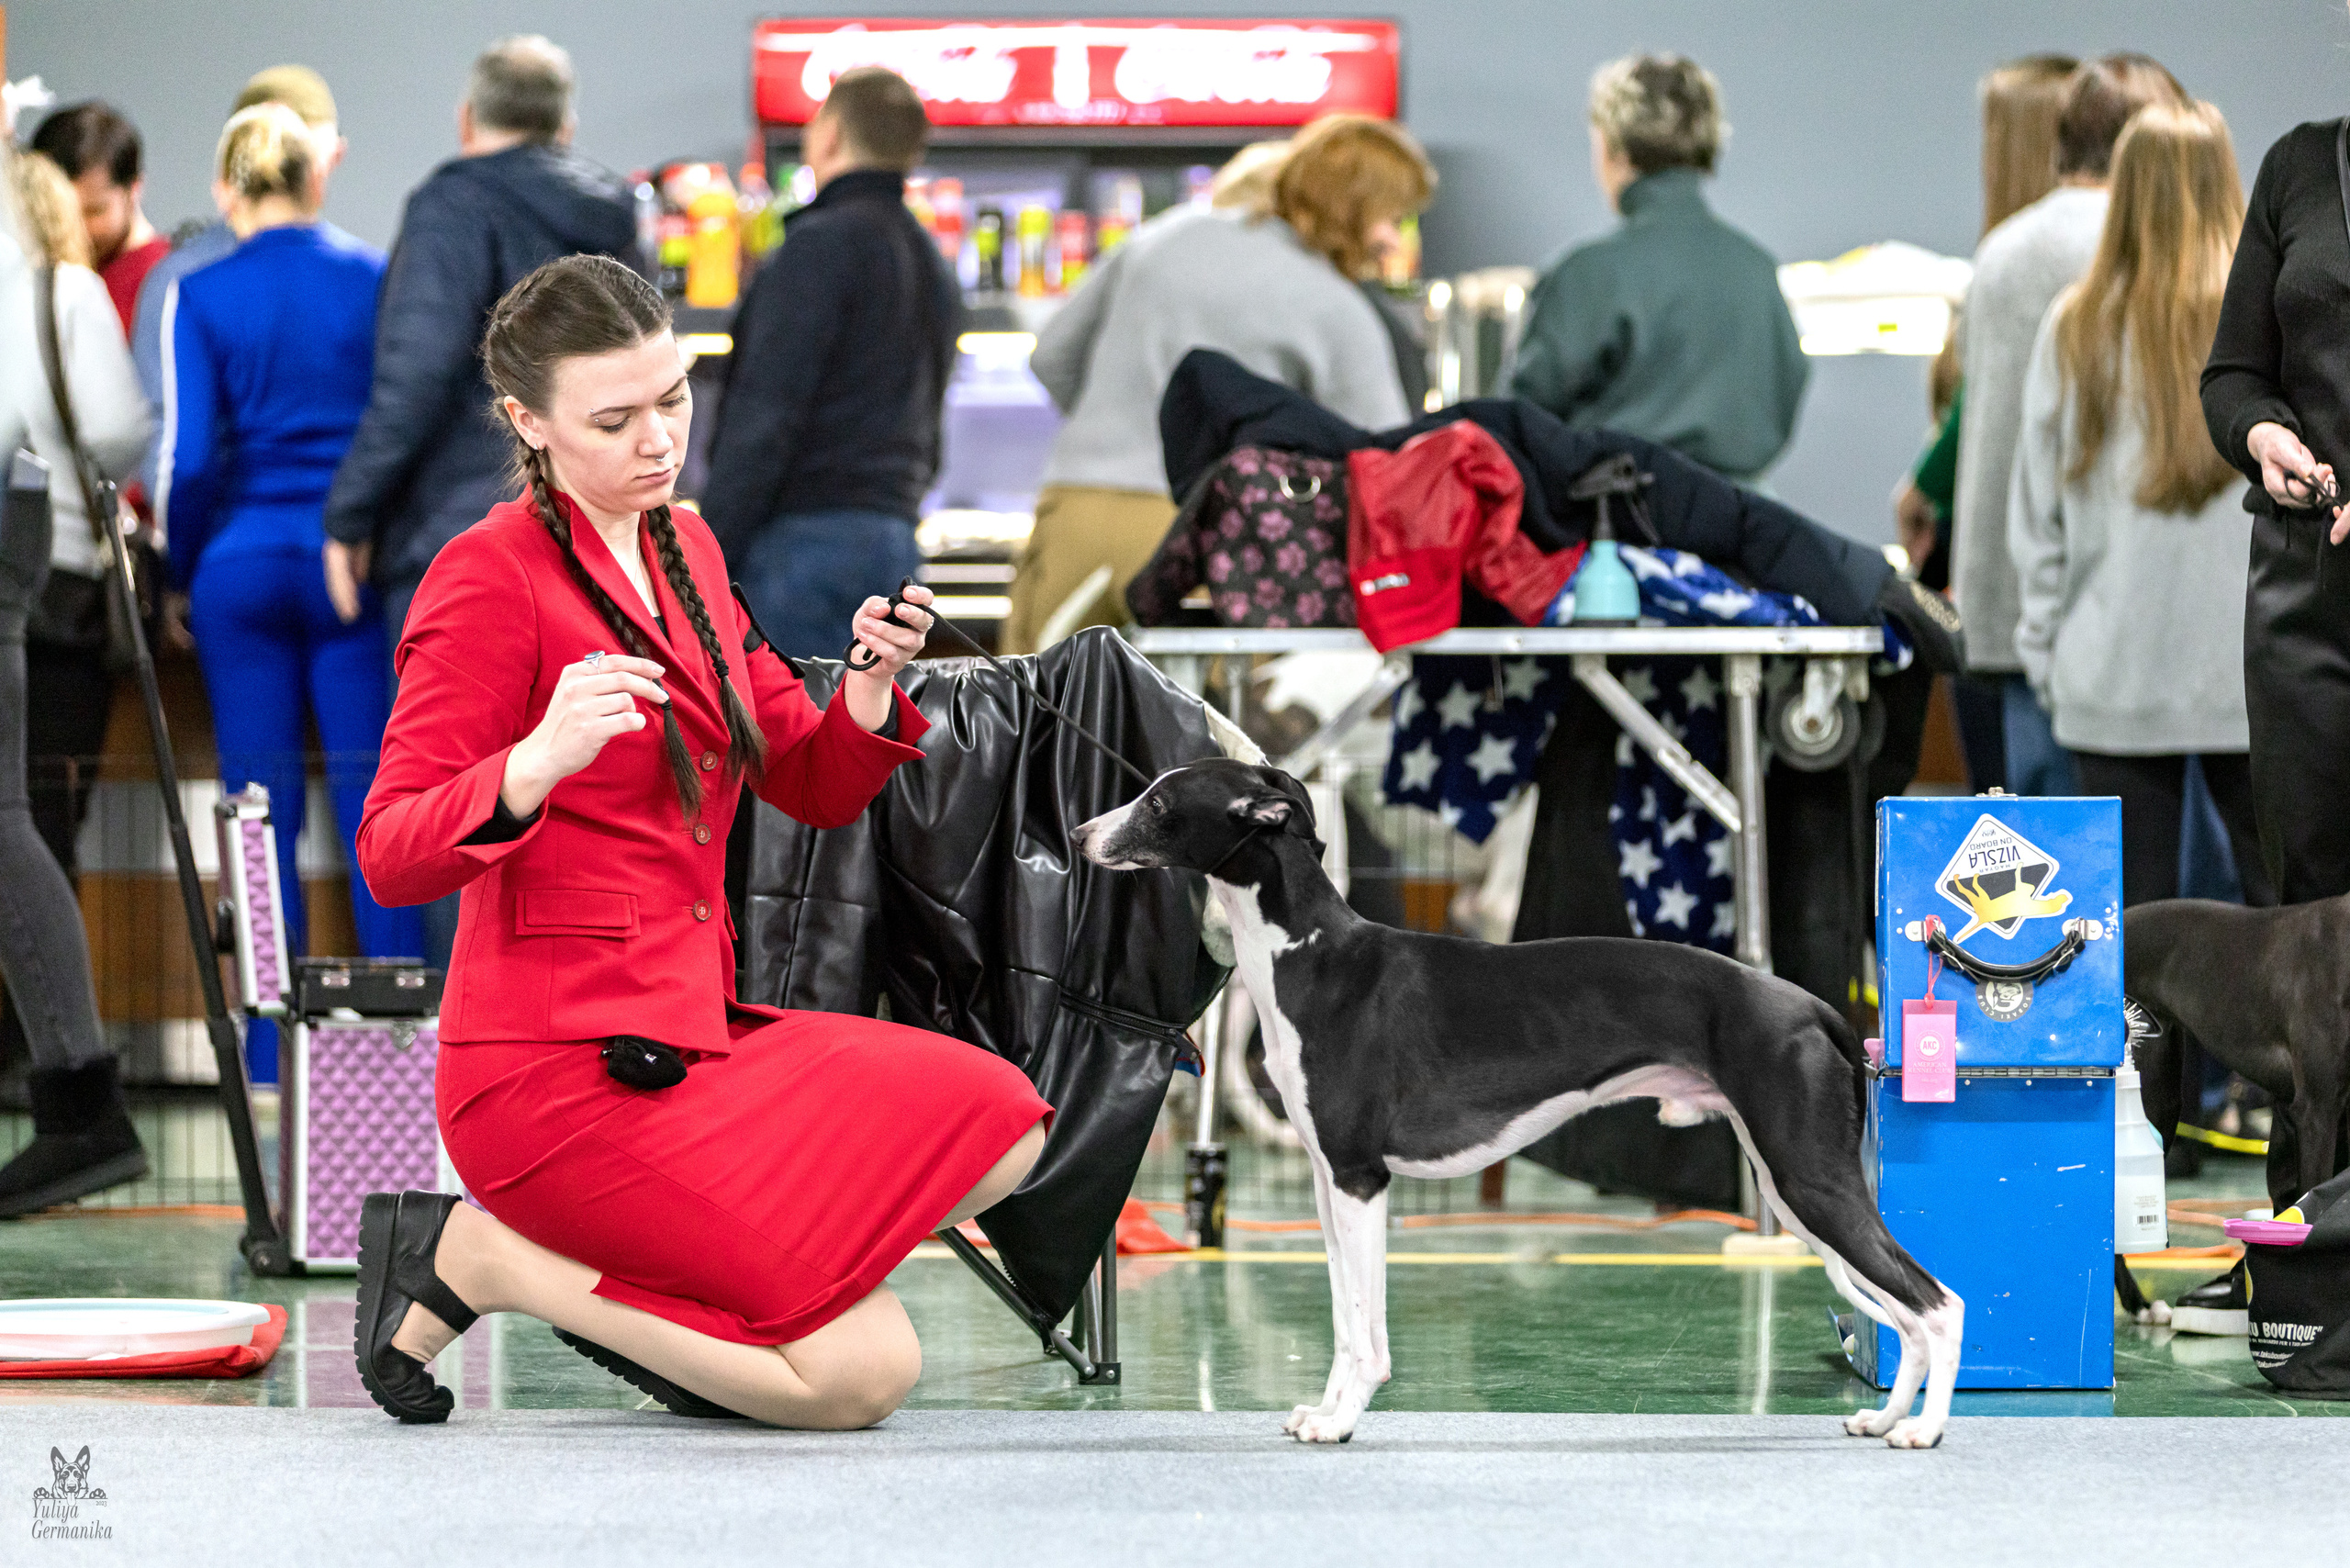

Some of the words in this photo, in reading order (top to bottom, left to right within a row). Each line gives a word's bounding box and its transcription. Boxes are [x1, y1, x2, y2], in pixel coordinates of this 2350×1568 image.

[1970, 839, 1998, 850] BOARD
[2000, 836, 2012, 845] ON
[1968, 845, 2020, 868] VIZSLA
[1922, 1040, 1937, 1050] AKC
